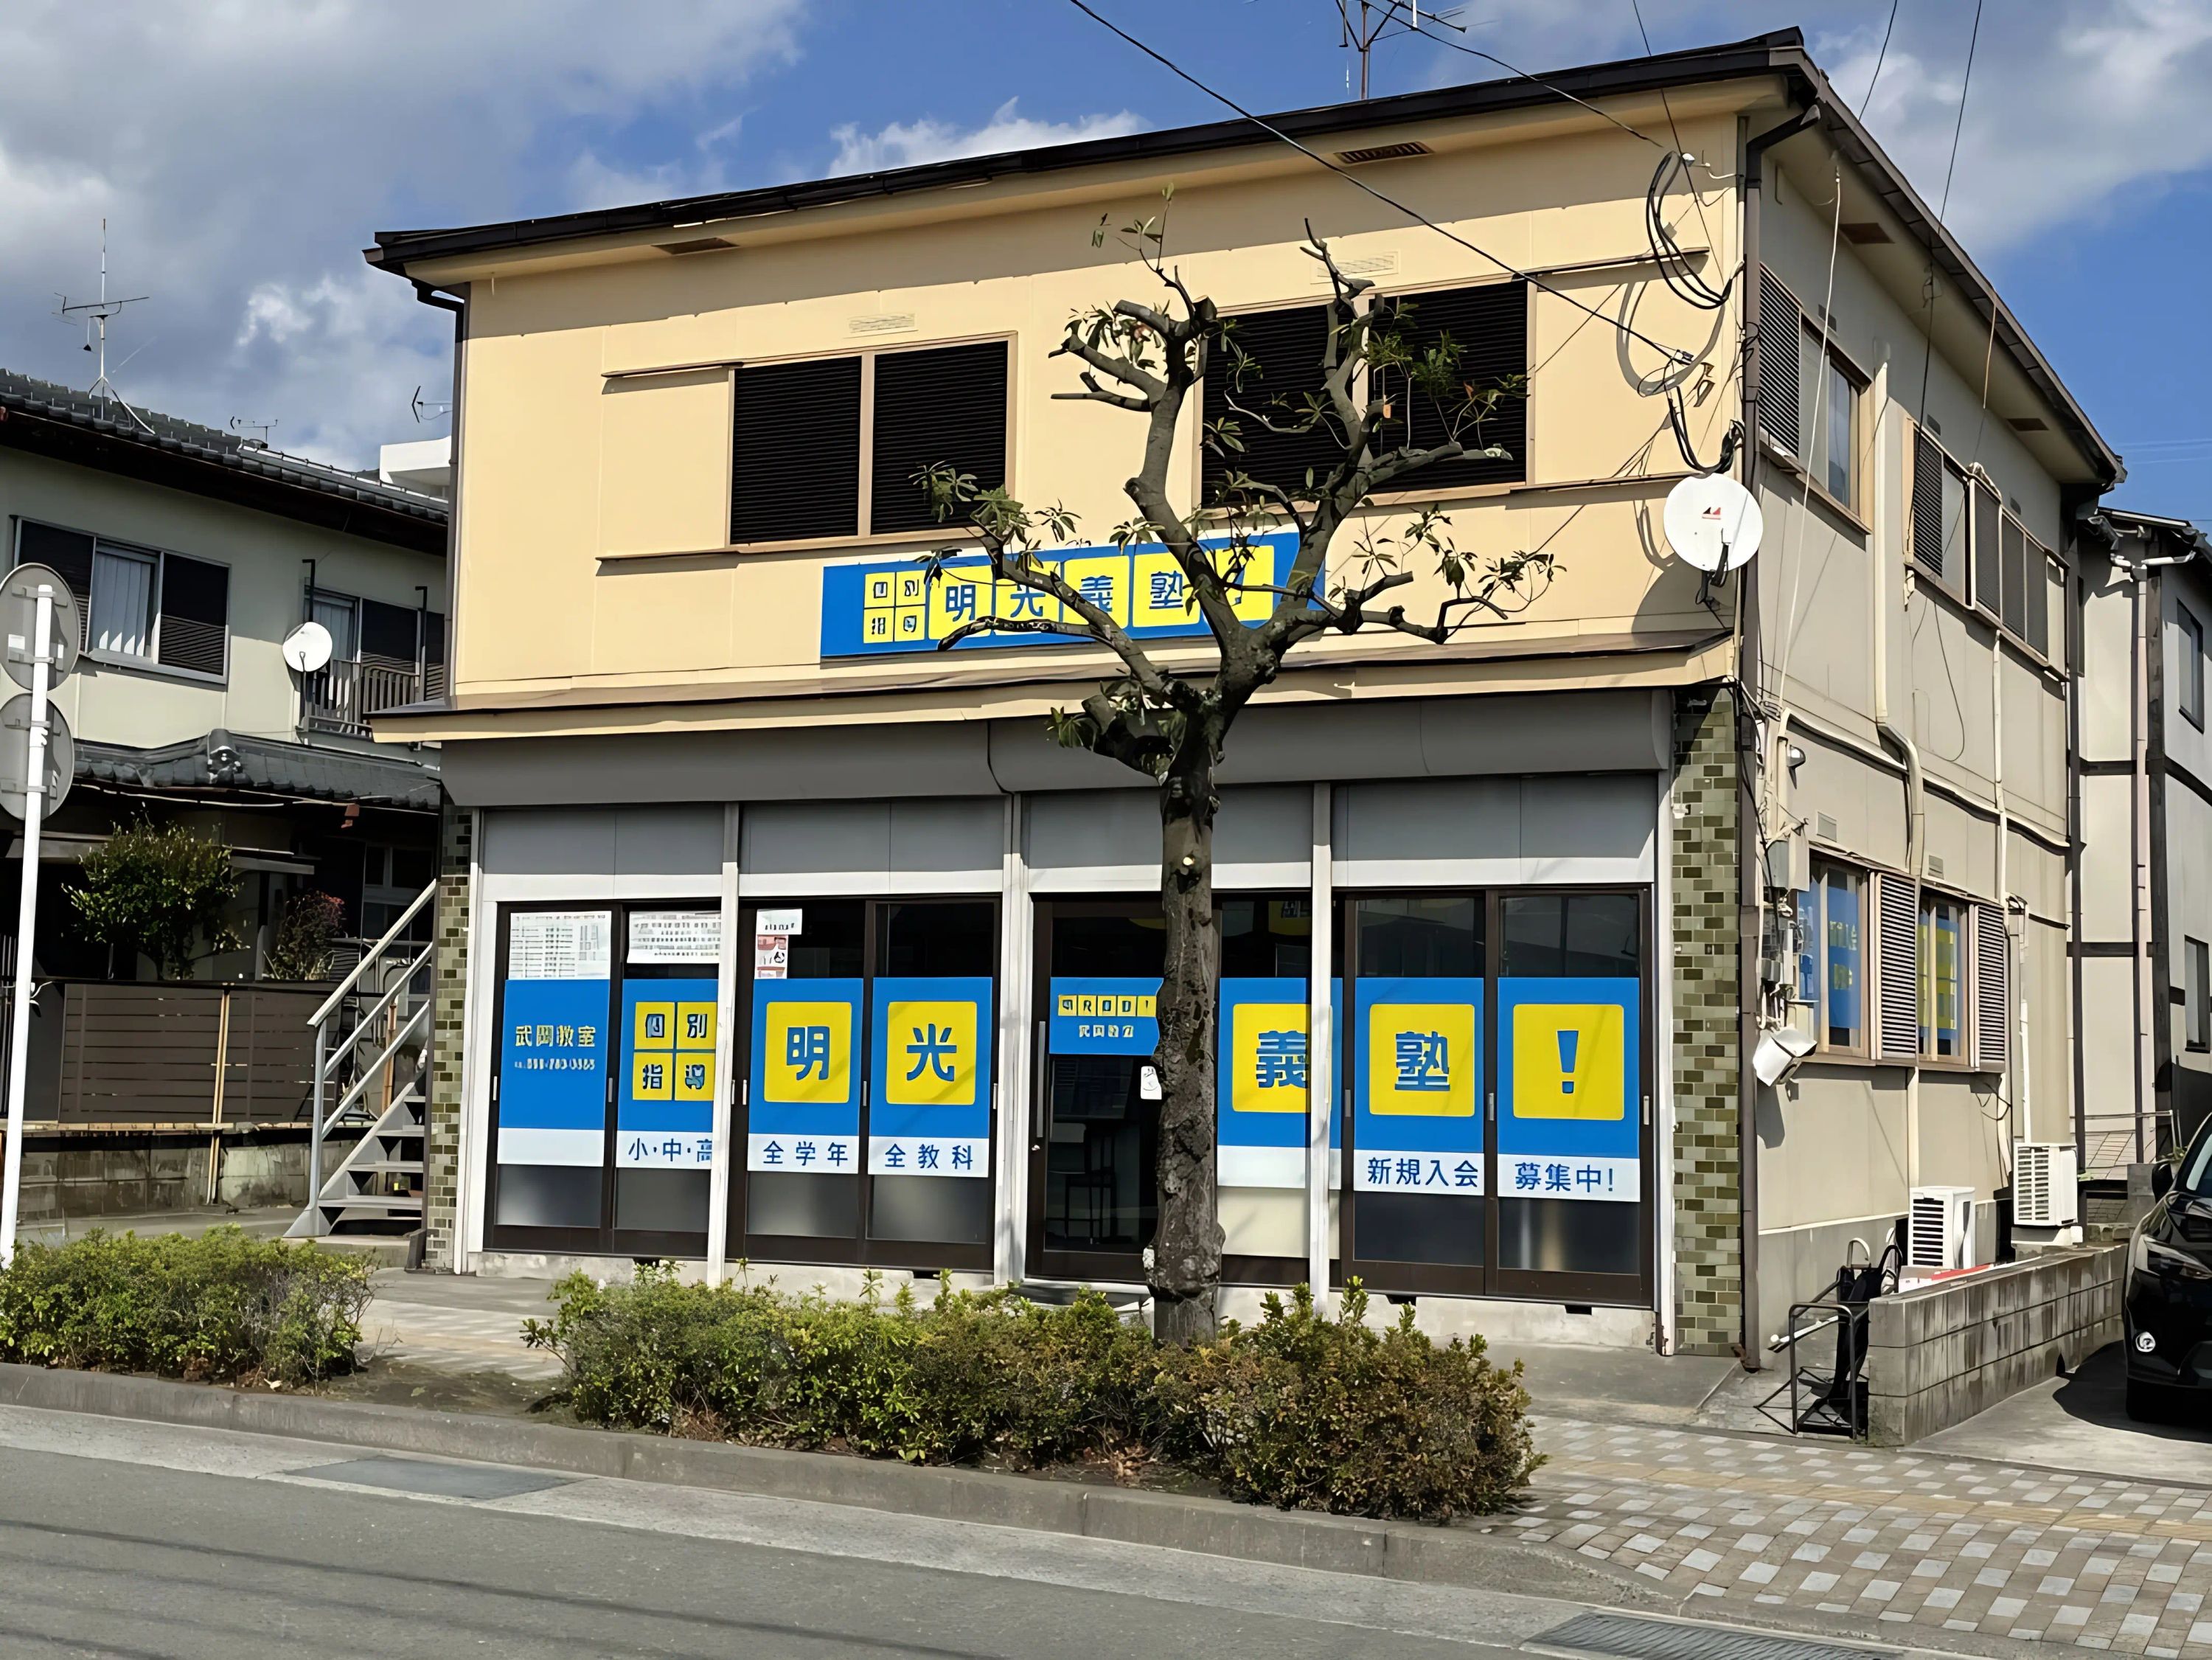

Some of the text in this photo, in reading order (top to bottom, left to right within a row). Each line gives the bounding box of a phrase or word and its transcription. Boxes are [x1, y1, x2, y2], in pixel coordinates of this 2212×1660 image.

[763, 1141, 848, 1167] 全学年
[885, 1144, 973, 1170] 全教科
[1368, 1157, 1478, 1187] 新規入会
[1514, 1162, 1613, 1192] 募集中!
